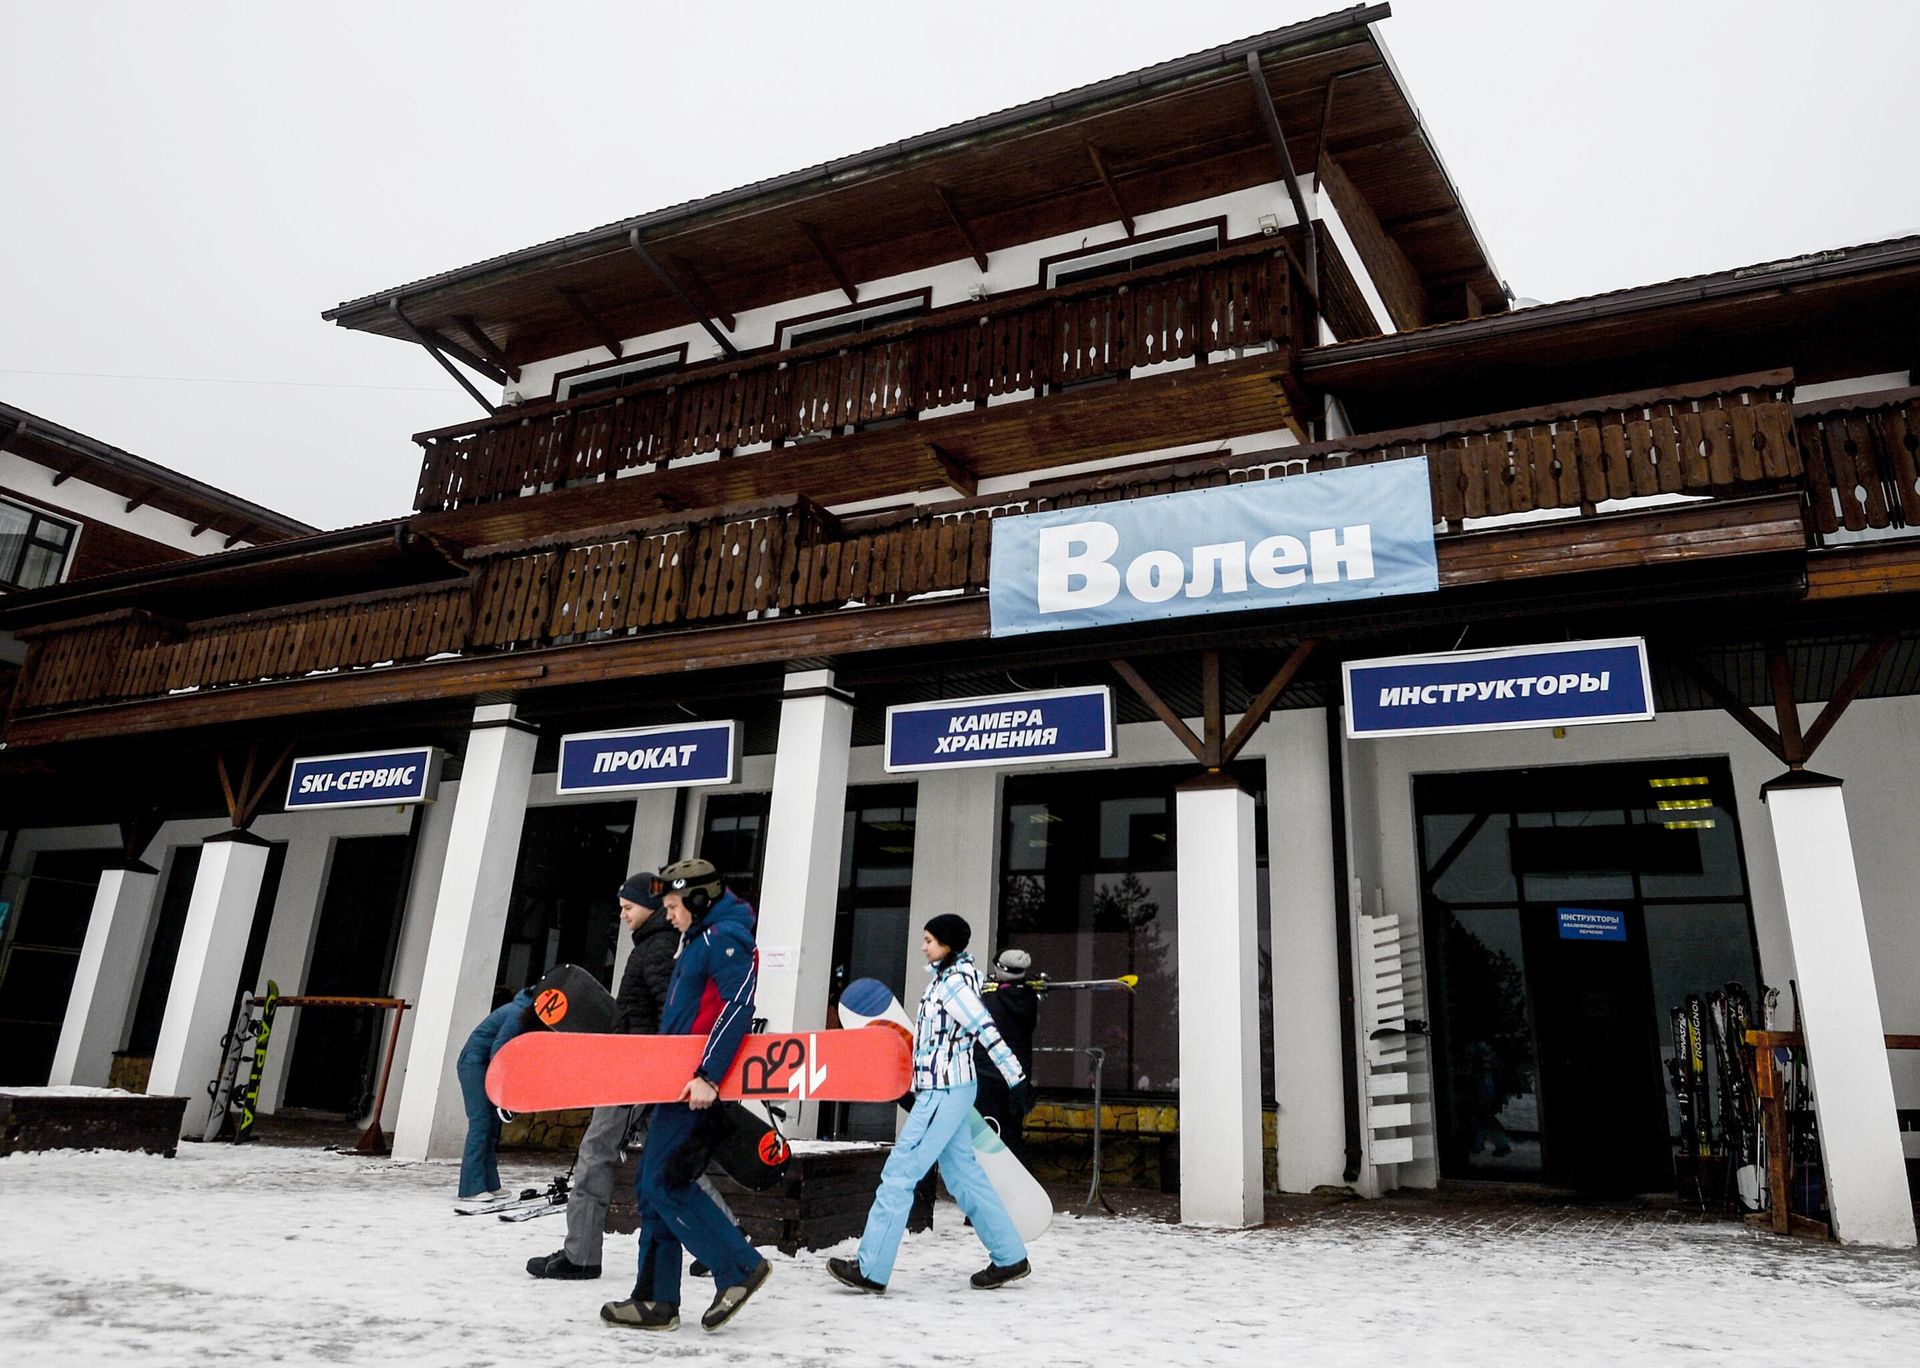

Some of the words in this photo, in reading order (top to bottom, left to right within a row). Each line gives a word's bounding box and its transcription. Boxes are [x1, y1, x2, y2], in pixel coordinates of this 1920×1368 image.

[1037, 520, 1376, 614] Волен
[1379, 671, 1611, 707] ИНСТРУКТОРЫ
[948, 708, 1043, 733] КАМЕРА
[934, 727, 1058, 754] ХРАНЕНИЯ
[592, 744, 697, 774] ПРОКАТ
[298, 765, 417, 794] SKI-СЕРВИС
[1560, 913, 1619, 923] ИНСТРУКТОРЫ
[1691, 999, 1703, 1058] ROSSIGNOL
